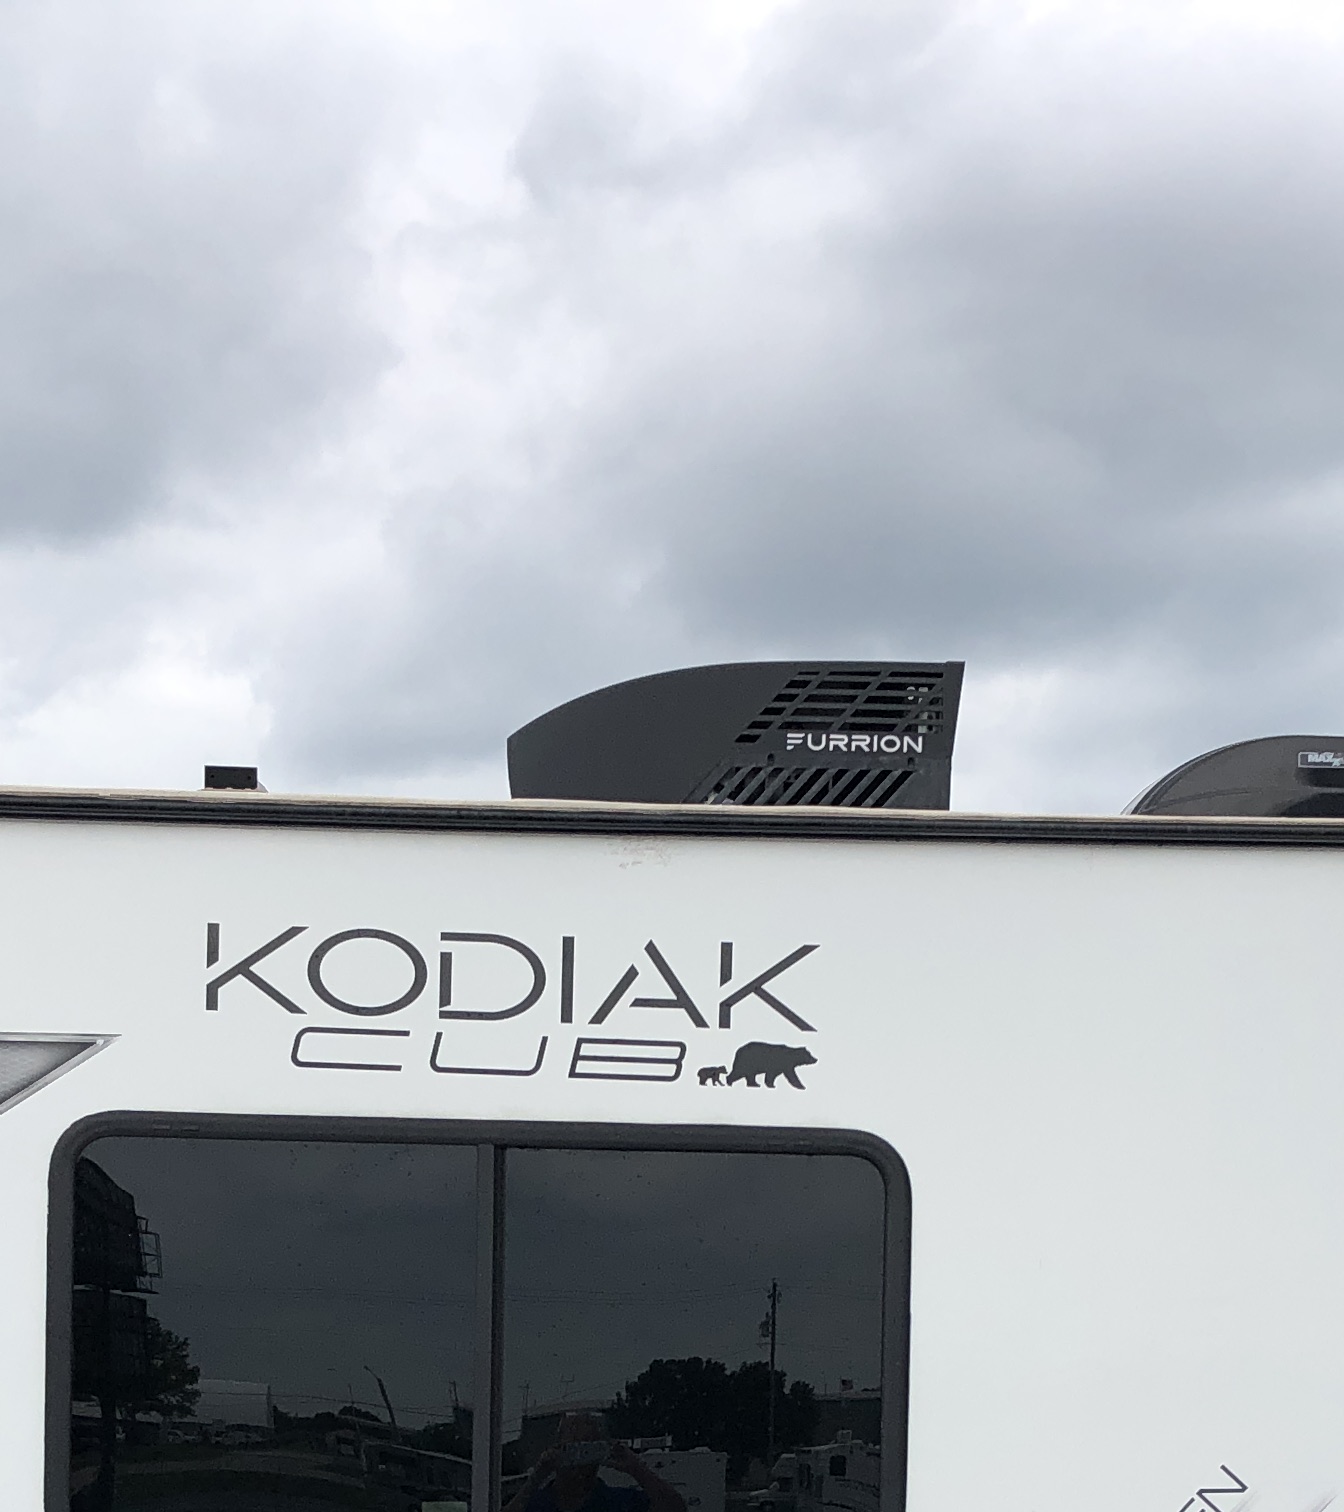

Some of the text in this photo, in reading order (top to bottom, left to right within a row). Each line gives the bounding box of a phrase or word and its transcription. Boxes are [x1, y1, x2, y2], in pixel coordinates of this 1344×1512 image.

[786, 732, 923, 754] FURRION
[205, 922, 821, 1033] KODIAK
[291, 1026, 687, 1082] CUB
